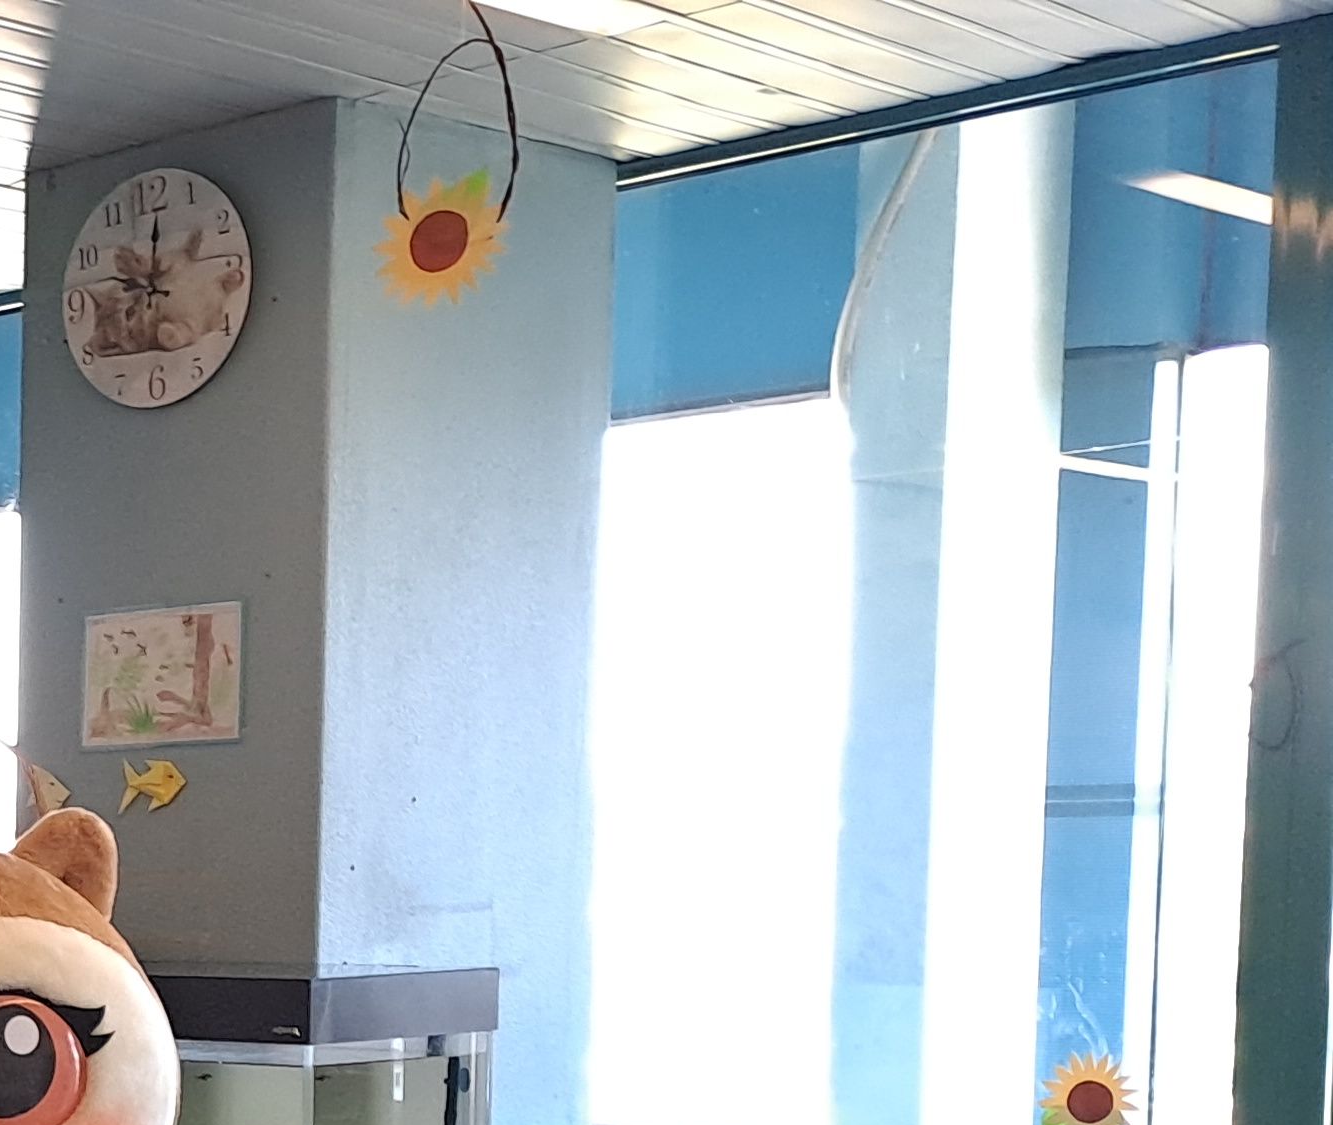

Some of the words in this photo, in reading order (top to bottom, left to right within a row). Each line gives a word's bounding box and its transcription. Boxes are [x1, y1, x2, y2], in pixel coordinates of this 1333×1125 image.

[136, 175, 169, 216] 12
[187, 181, 197, 205] 1
[104, 202, 122, 228] 11
[217, 209, 231, 235] 2
[78, 244, 99, 271] 10
[67, 288, 85, 324] 9
[148, 365, 166, 401] 6
